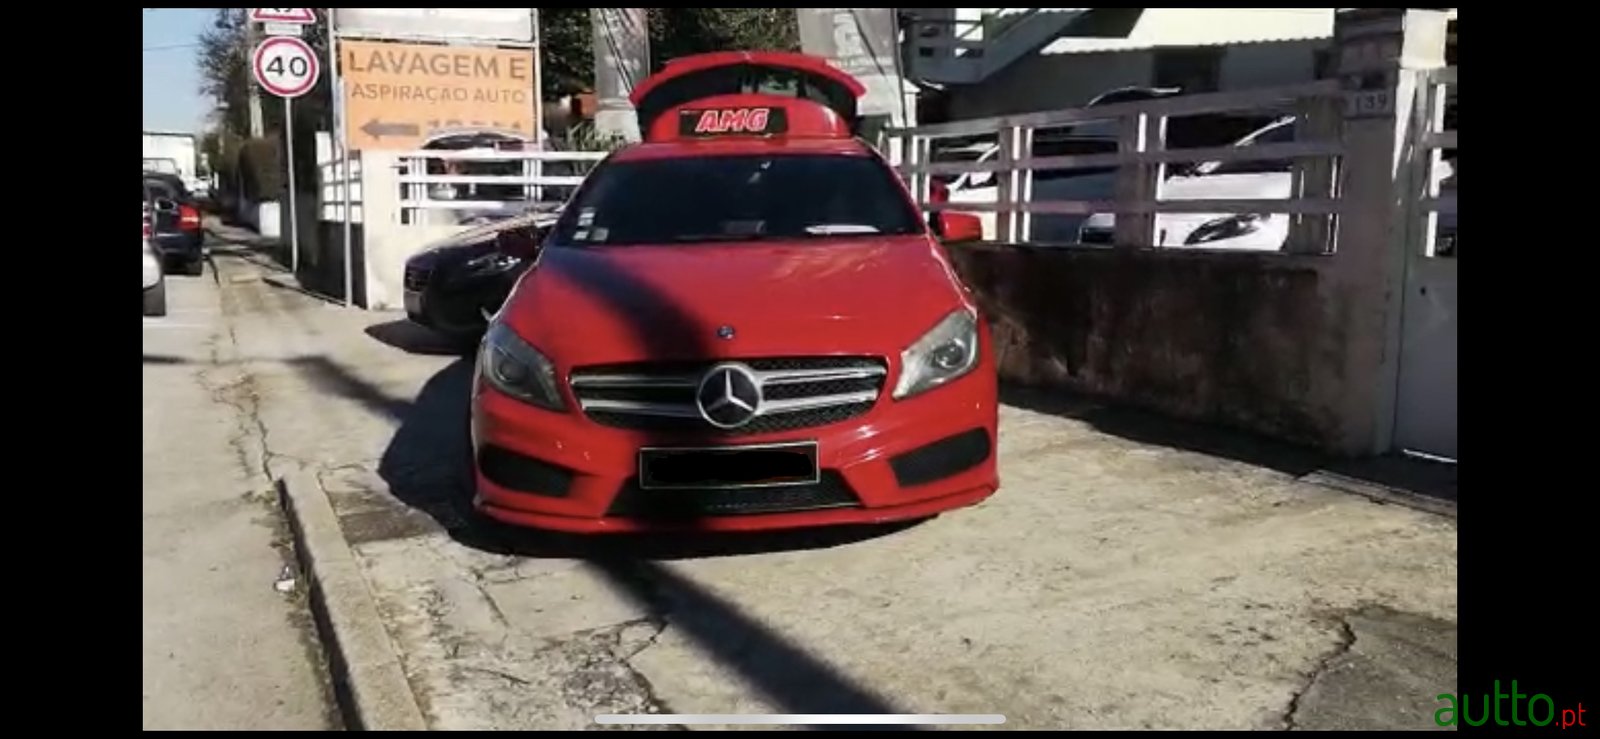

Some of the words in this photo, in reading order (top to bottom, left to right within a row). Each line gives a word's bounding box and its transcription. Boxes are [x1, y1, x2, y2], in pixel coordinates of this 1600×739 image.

[265, 54, 308, 77] 40
[349, 50, 499, 78] LAVAGEM
[509, 57, 527, 81] E
[474, 86, 526, 103] AUTO
[694, 107, 770, 132] AMG
